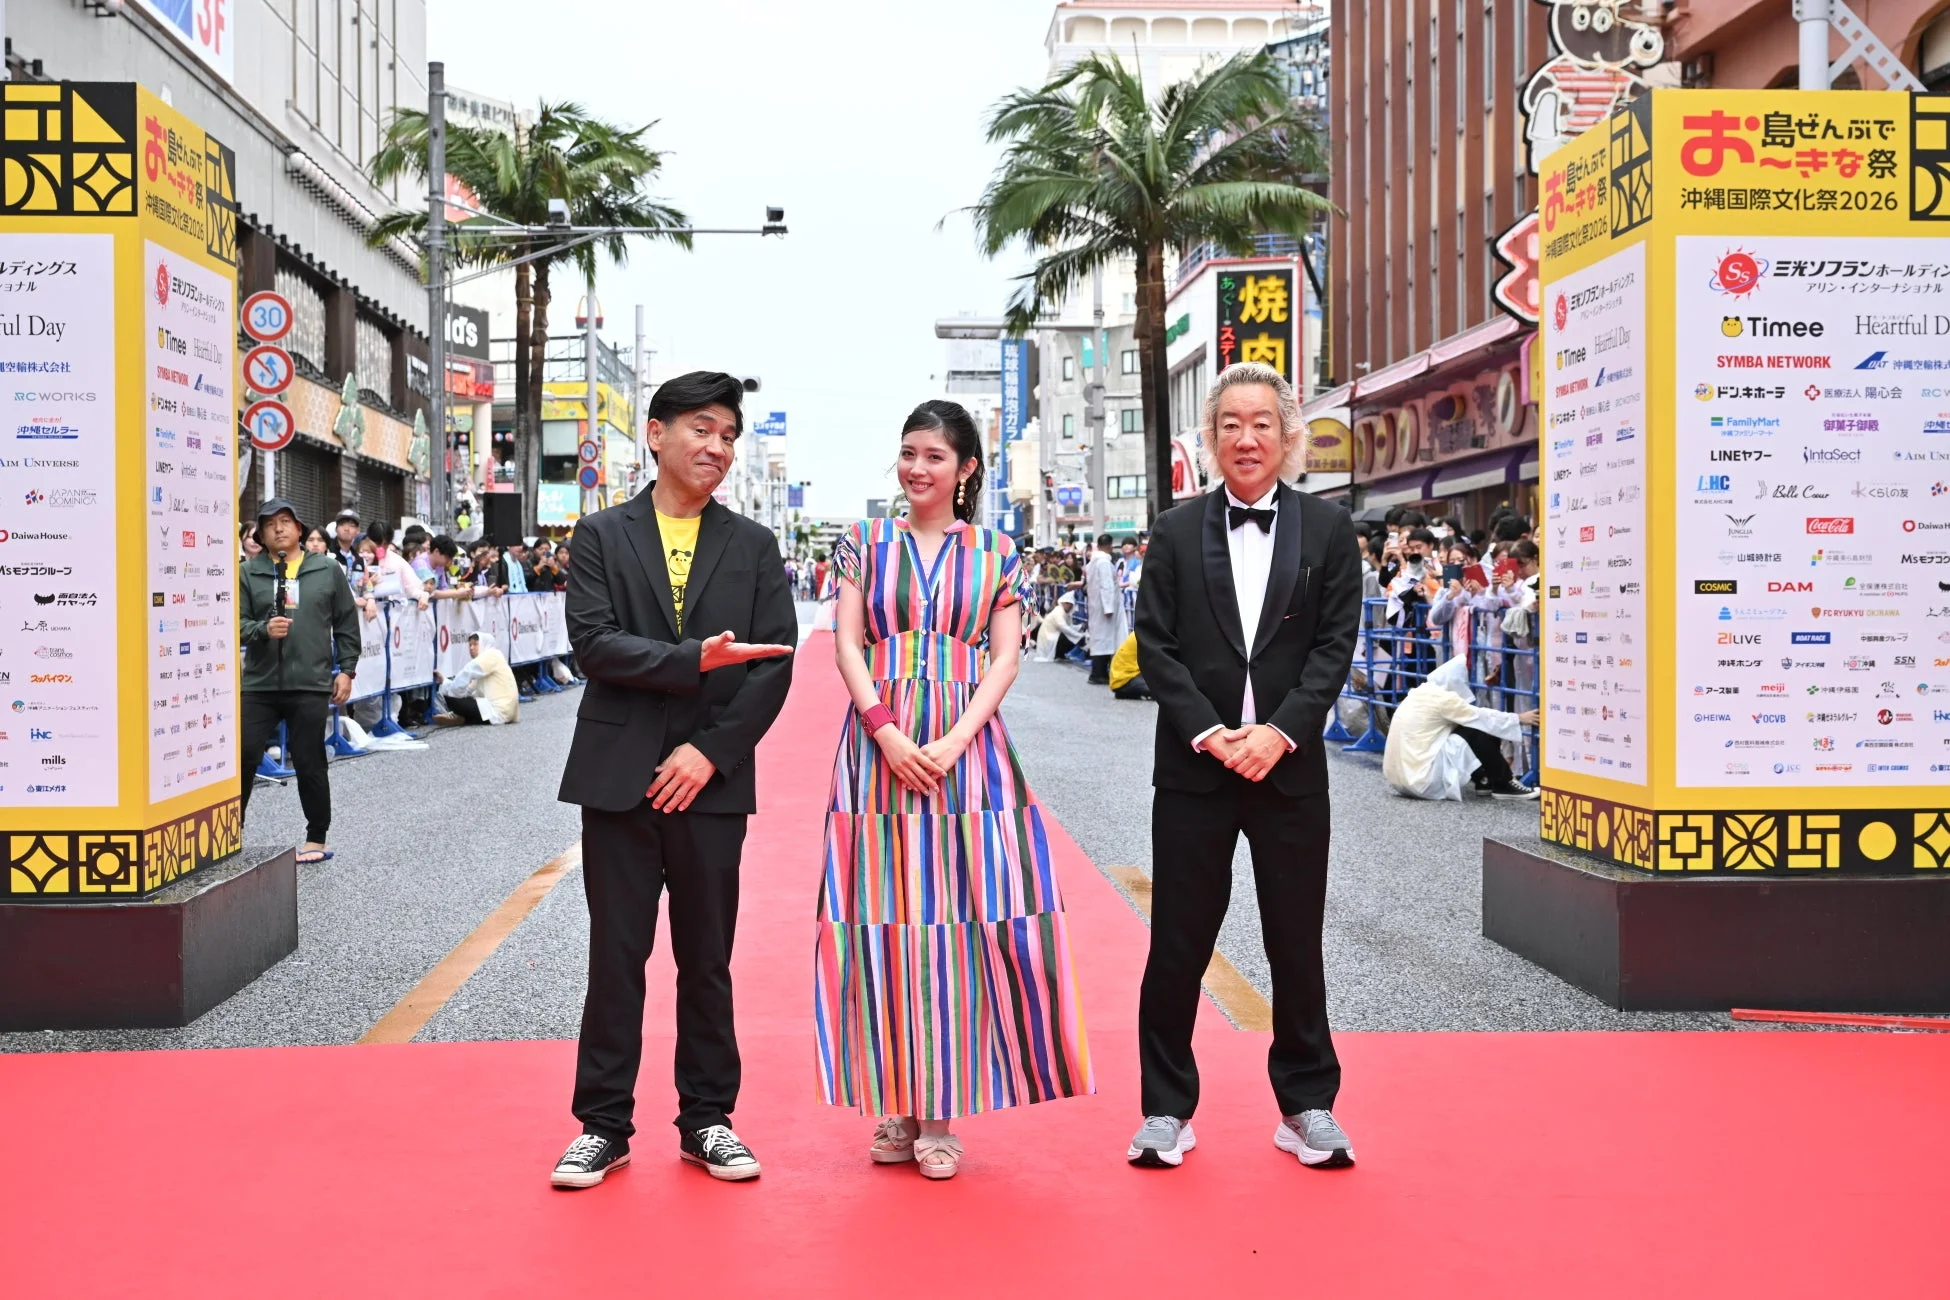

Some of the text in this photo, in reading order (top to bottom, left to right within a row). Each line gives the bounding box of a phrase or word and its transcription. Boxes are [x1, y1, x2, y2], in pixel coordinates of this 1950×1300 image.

[1761, 111, 1897, 149] 島ぜんぶで
[1680, 187, 1899, 211] 沖縄国際文化祭2026
[145, 190, 205, 242] 沖縄国際文化祭2026
[1544, 215, 1608, 263] 沖縄国際文化祭2026
[0, 281, 38, 292] ョナル
[1806, 282, 1944, 294] アリン・インターナショナル
[254, 305, 283, 329] 30
[0, 314, 66, 342] ul Day
[1747, 317, 1824, 338] Timee
[1855, 314, 1928, 335] Heartful
[165, 329, 187, 356] Timee
[1563, 346, 1587, 368] Timee
[1717, 355, 1831, 369] SYMBA NETWORK
[40, 392, 96, 401] WORKS
[1824, 388, 1862, 398] 医療法人
[1865, 386, 1903, 399] 陽心会
[1726, 417, 1780, 428] FamilyMart
[1823, 419, 1879, 432] 御菓子御殿
[17, 425, 79, 435] 沖縄セルラー
[1710, 450, 1772, 462] LINEヤフー
[1868, 487, 1909, 498] くらしの友
[1568, 587, 1582, 596] DAM
[1699, 582, 1813, 592] COSMIC DAM
[172, 593, 186, 604] DAM
[1823, 609, 1900, 617] FC RYUKYU OKINAWA
[21, 620, 48, 632] 上原
[1705, 687, 1740, 695] アース製薬
[1761, 683, 1785, 693] meiji
[1703, 713, 1731, 722] HEIWA
[1763, 714, 1786, 723] OCVB
[41, 756, 66, 765] mills
